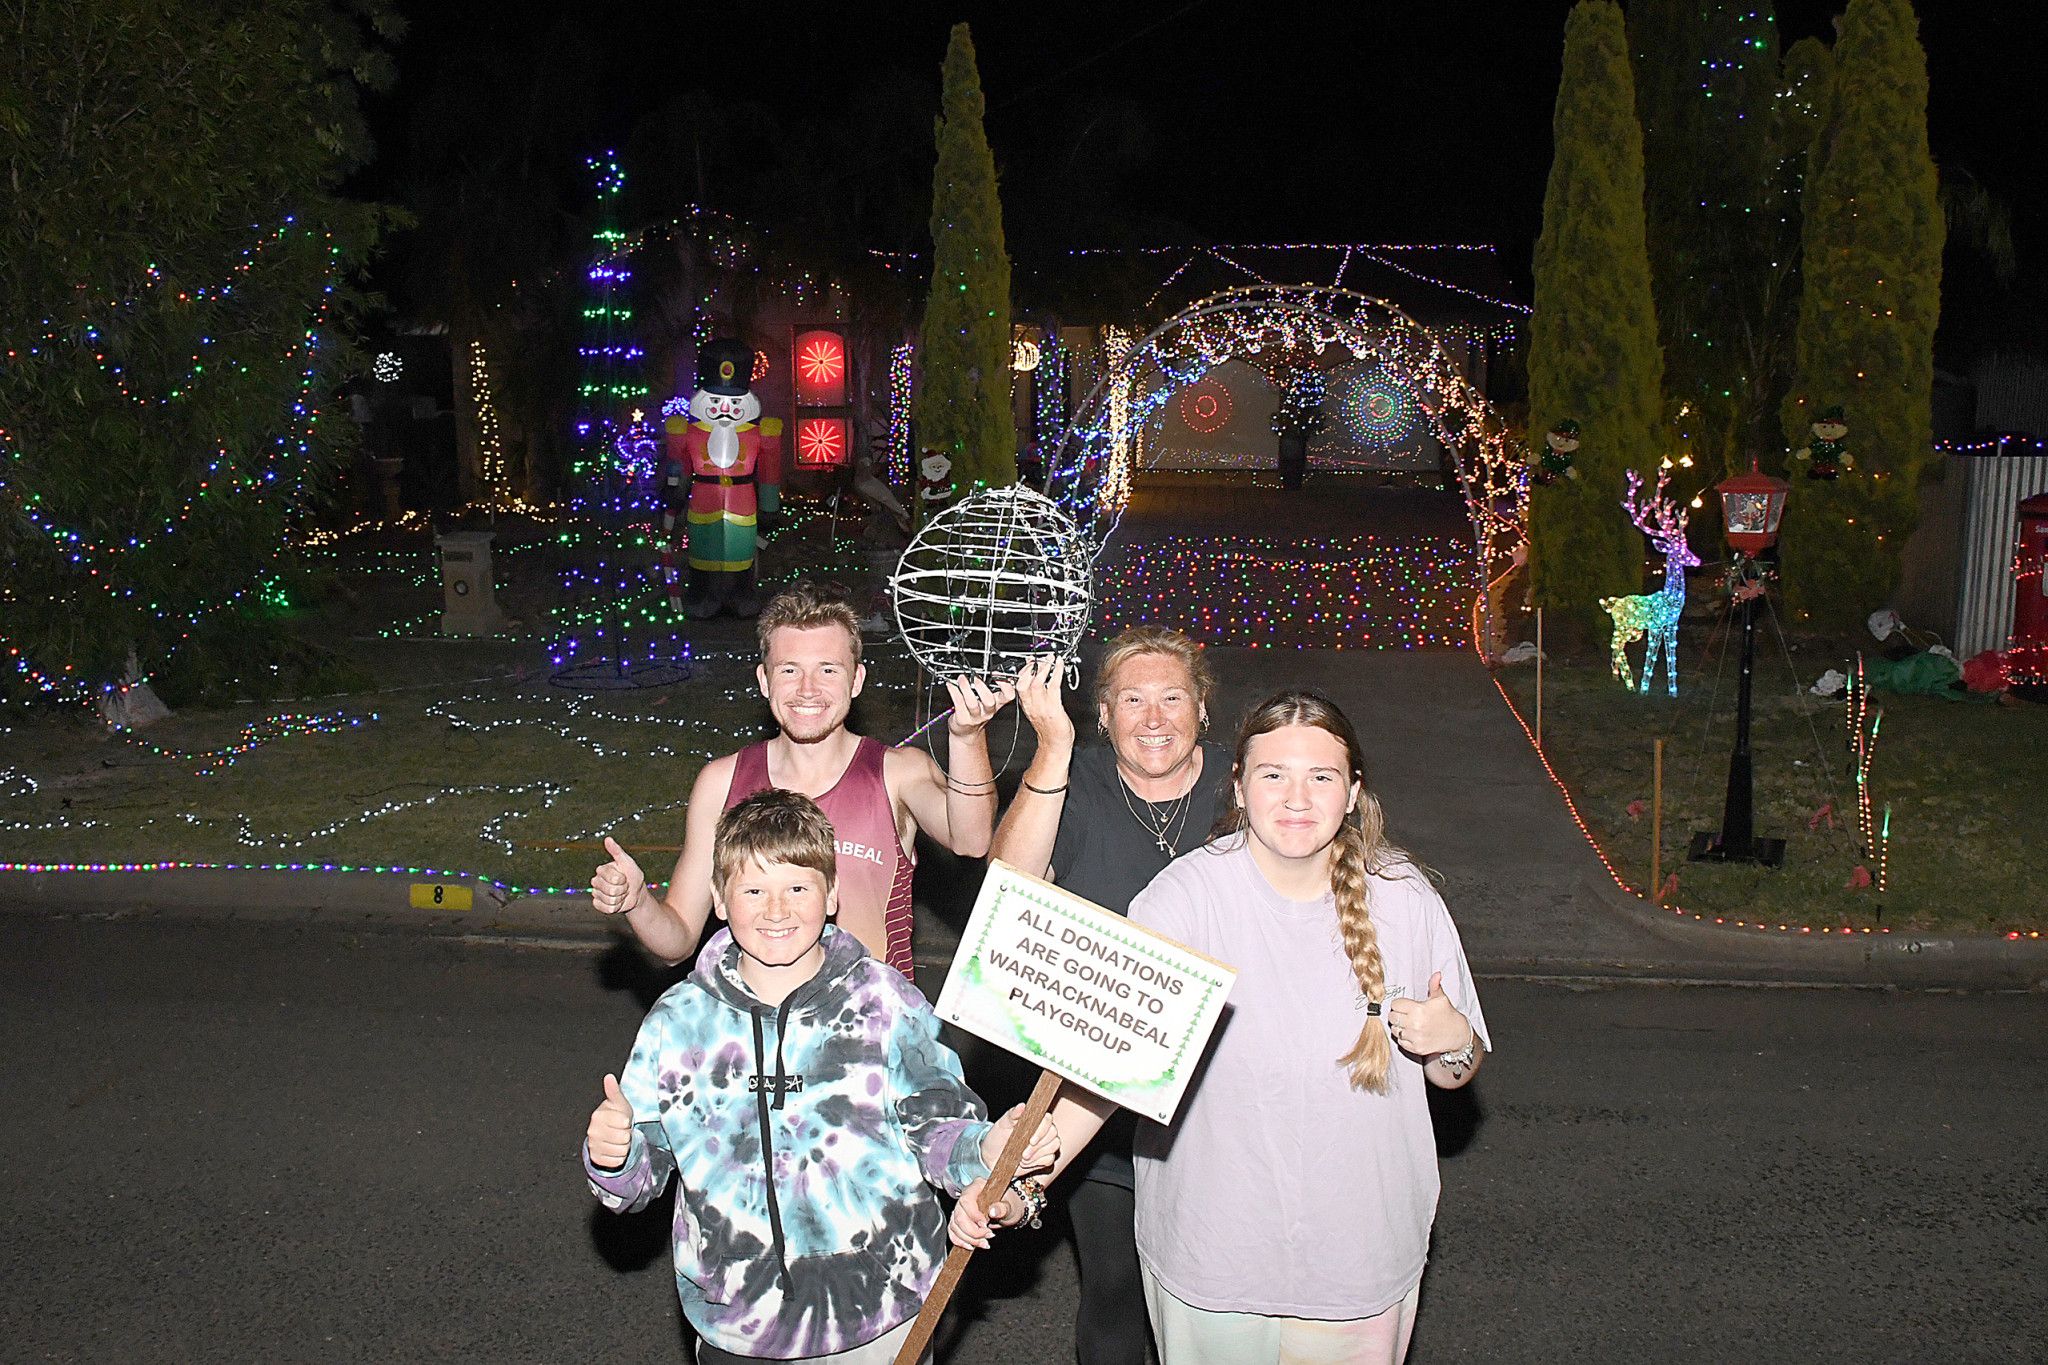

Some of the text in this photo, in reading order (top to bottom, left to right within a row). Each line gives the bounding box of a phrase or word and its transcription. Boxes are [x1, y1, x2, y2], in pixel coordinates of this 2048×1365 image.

[434, 885, 444, 904] 8
[1016, 936, 1164, 1015] ARE GOING TO
[1017, 909, 1184, 995] ALL DONATIONS
[989, 949, 1170, 1049] WARRACKNABEAL
[1008, 986, 1132, 1054] PLAYGROUP
